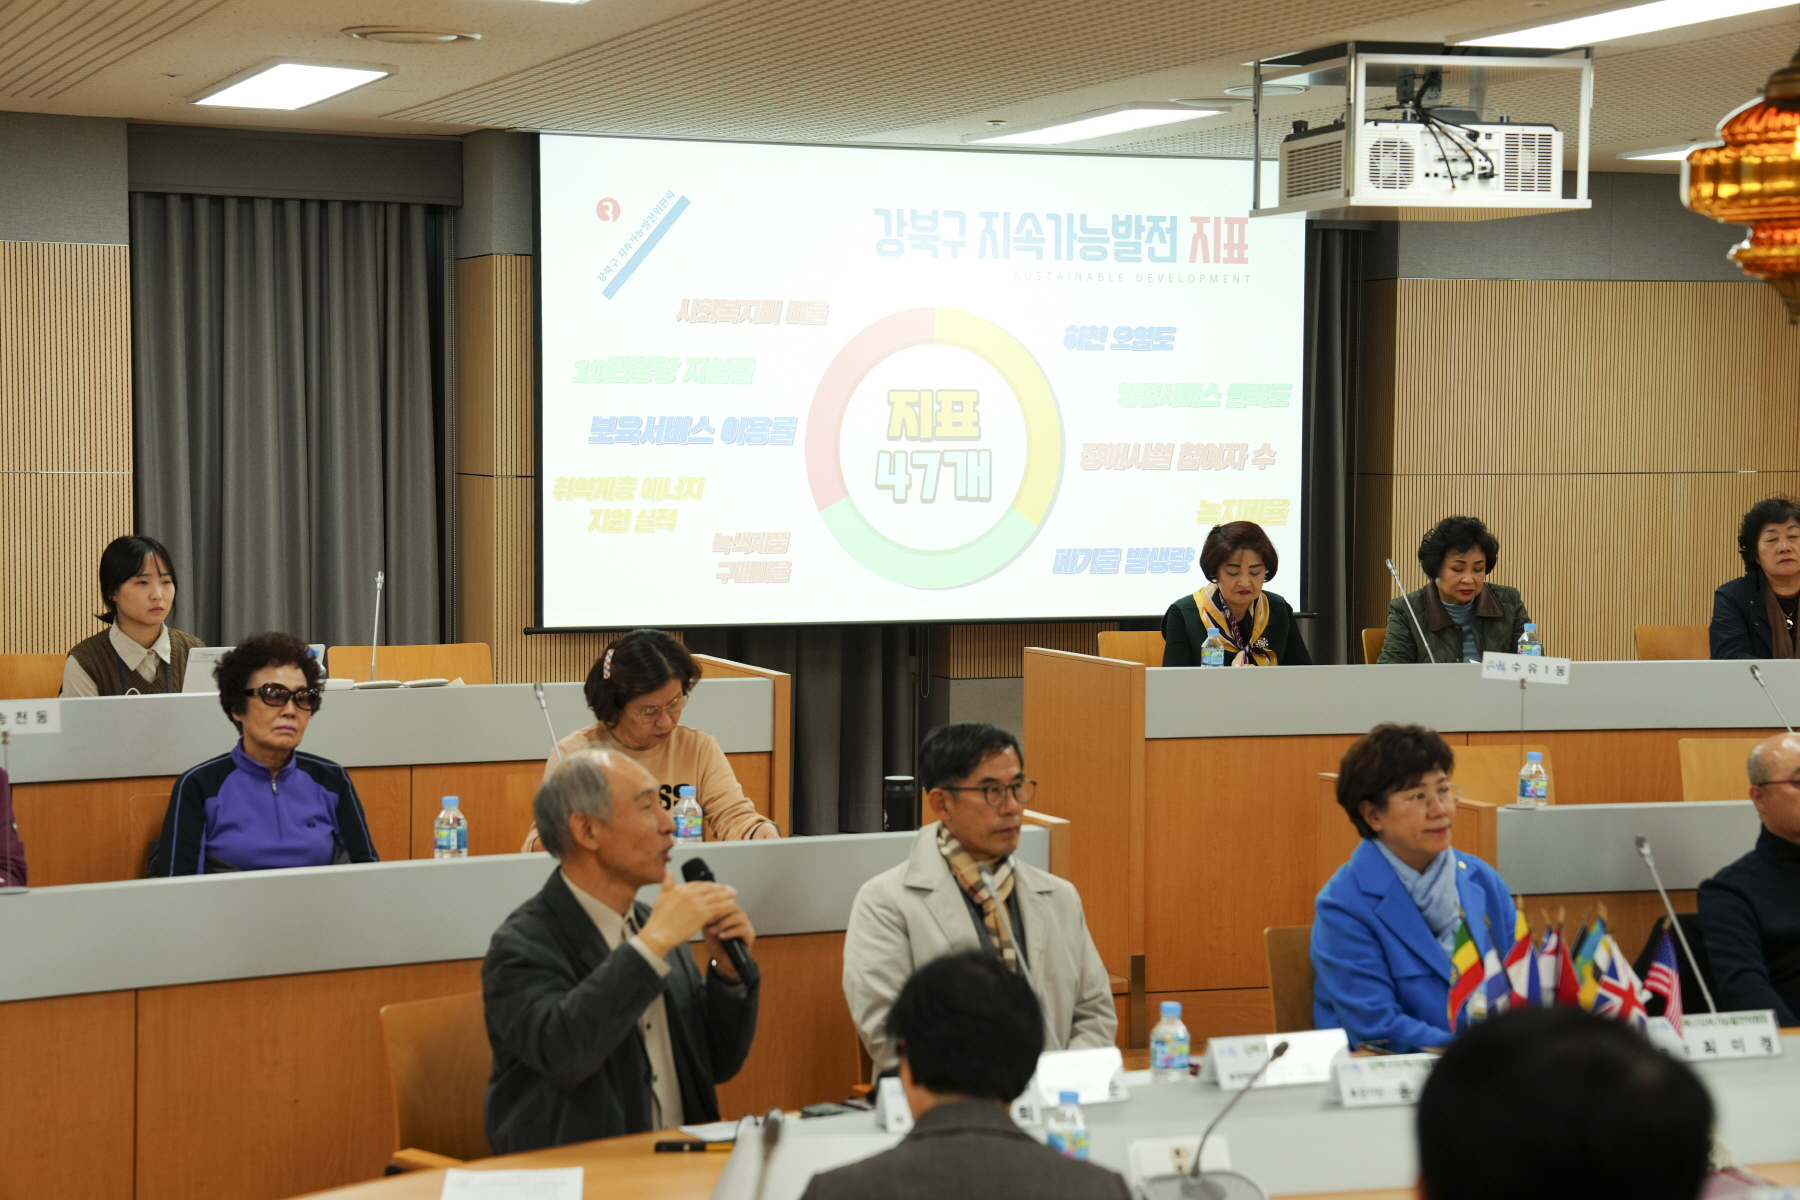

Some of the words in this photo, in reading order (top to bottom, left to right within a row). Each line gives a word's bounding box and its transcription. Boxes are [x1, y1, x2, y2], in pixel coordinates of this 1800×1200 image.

[596, 257, 619, 283] 강북구
[617, 189, 676, 259] 지속가능발전위원회
[873, 208, 967, 259] 강북구
[979, 211, 1178, 264] 지속가능발전
[1189, 216, 1249, 264] 지표
[1015, 271, 1125, 283] SUSTAINABLE
[1136, 273, 1251, 285] DEVELOPMENT
[675, 297, 783, 325] 사회복지비
[784, 300, 830, 325] 비율
[1063, 324, 1109, 351] 하천
[1109, 326, 1177, 352] 오염도
[571, 355, 681, 385] 10만명당
[681, 356, 757, 385] 자살률
[1117, 381, 1222, 409] 행정서비스
[1225, 383, 1293, 409] 만족도
[886, 388, 982, 442] 지표
[587, 415, 716, 446] 보육서비스
[719, 416, 799, 447] 이용률
[1176, 442, 1250, 471] 참여자
[1250, 444, 1277, 471] 수
[552, 475, 638, 502] 취약계층
[640, 476, 706, 502] 에너지
[874, 448, 993, 505] 47개
[587, 508, 632, 533] 지원
[633, 508, 679, 533] 실적
[1195, 498, 1291, 526] 녹지비율
[712, 531, 791, 555] 녹색제품
[1052, 547, 1123, 575] 폐기물
[1124, 547, 1196, 575] 발생량
